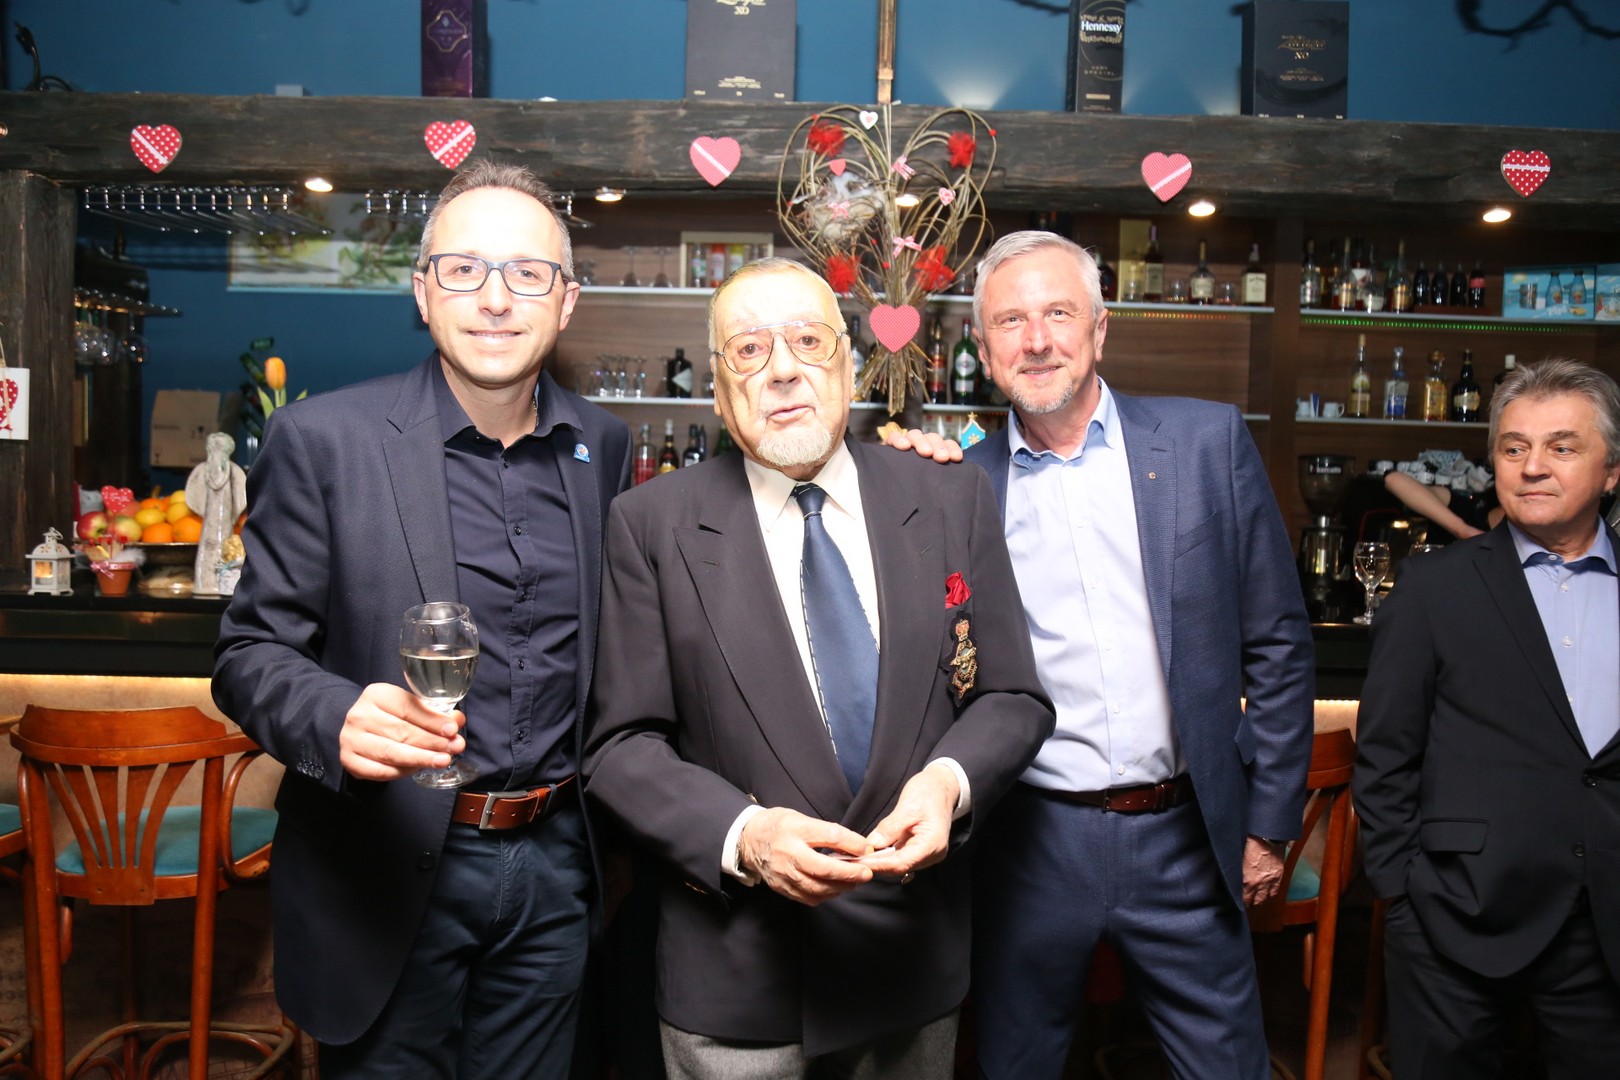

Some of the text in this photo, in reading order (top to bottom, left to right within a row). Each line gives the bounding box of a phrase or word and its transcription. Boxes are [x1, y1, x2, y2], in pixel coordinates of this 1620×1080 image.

[734, 6, 750, 16] XO
[1081, 20, 1122, 34] Hennessy
[1294, 51, 1310, 60] XO
